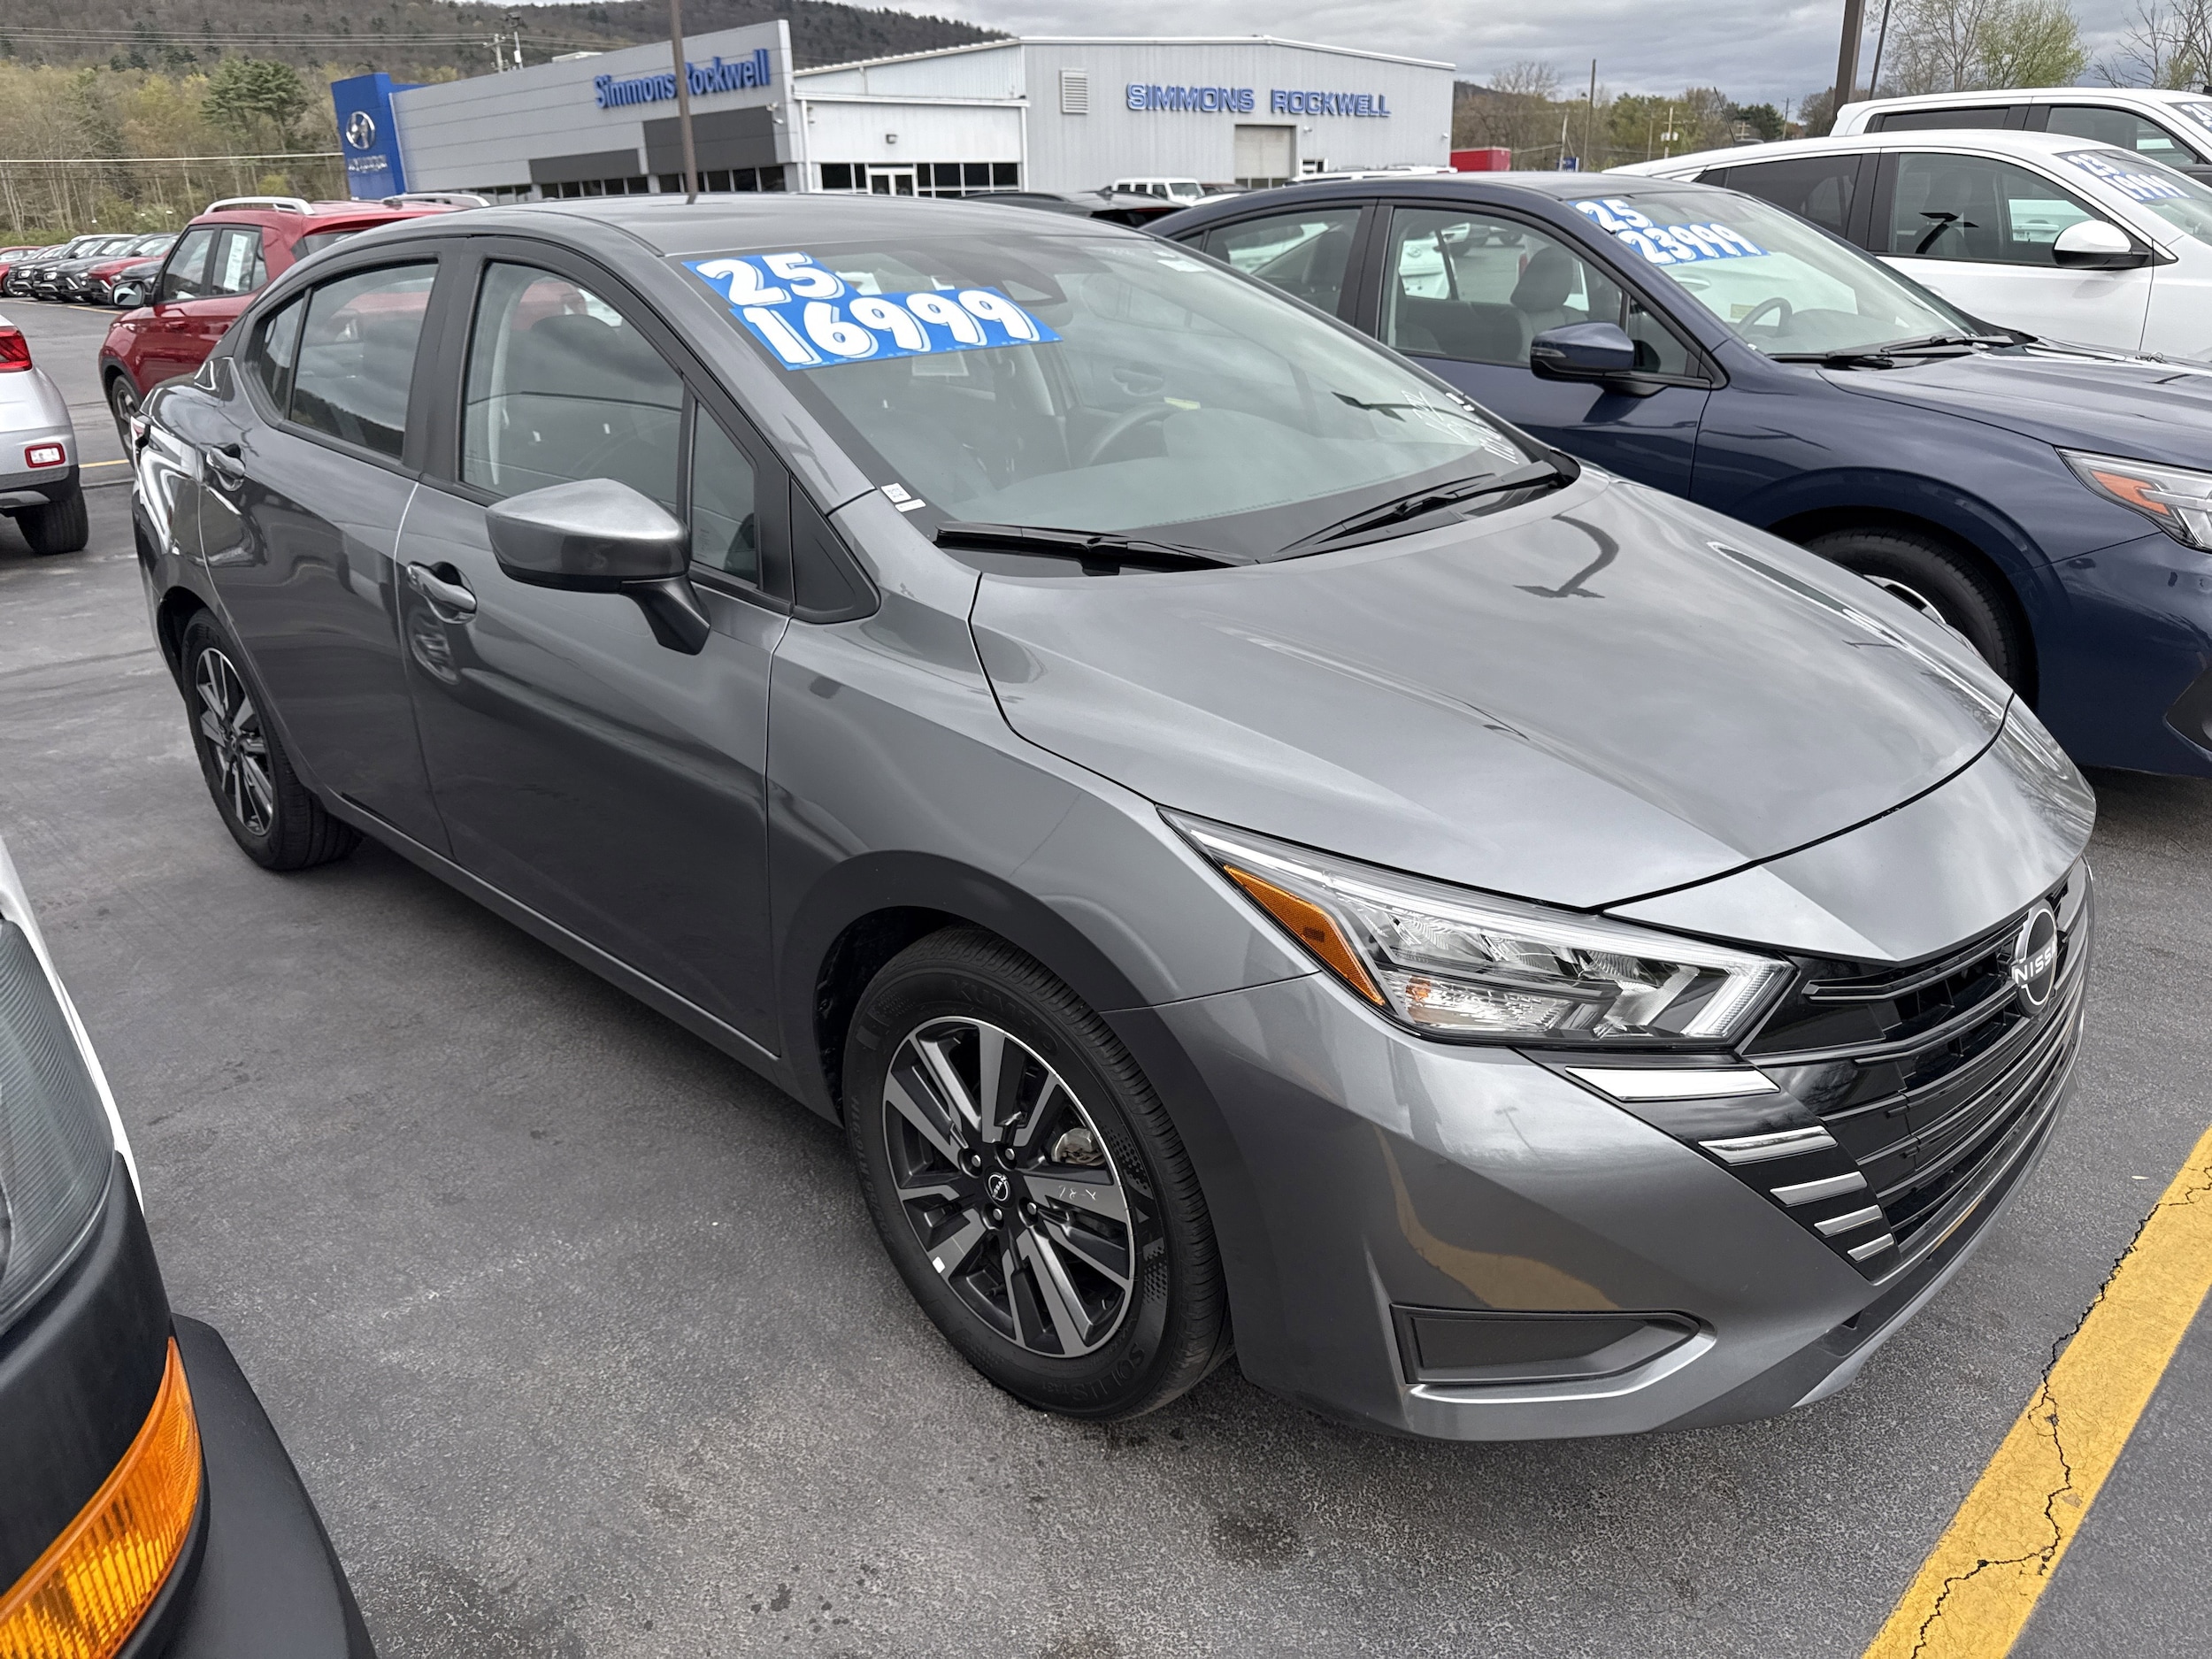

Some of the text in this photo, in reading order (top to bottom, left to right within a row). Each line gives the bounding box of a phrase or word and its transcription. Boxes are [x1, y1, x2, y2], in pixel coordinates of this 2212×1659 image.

[594, 48, 771, 110] Simmons Rockwell
[1127, 83, 1393, 118] SIMMONS ROCKWELL
[1575, 199, 1654, 231] 25
[1617, 223, 1763, 265] 23999
[695, 251, 845, 306] 25
[743, 289, 1041, 365] 16999
[2012, 940, 2058, 985] NISS
[1069, 1342, 1146, 1402] SOLUS
